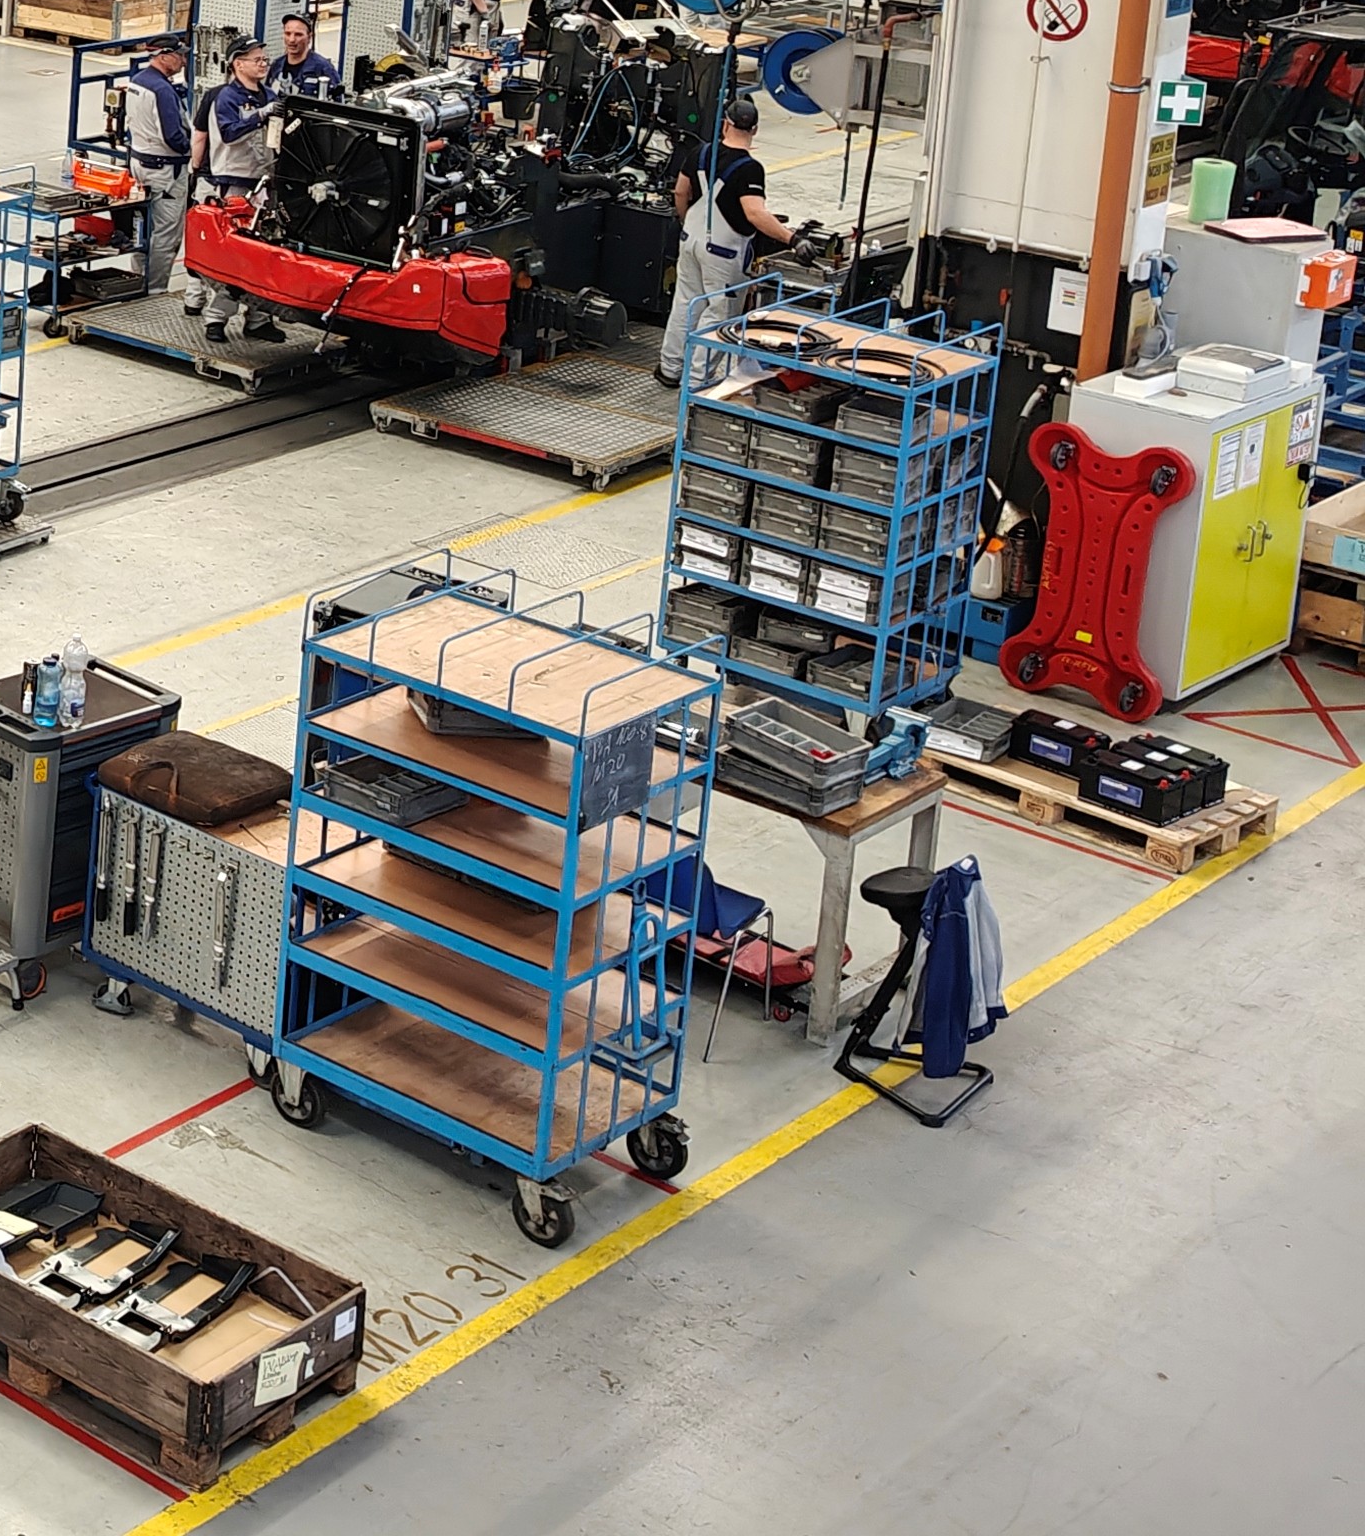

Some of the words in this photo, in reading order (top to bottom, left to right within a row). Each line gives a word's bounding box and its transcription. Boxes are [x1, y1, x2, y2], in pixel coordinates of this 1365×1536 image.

[413, 284, 421, 293] R
[361, 1291, 463, 1374] M20
[445, 1252, 528, 1299] 31
